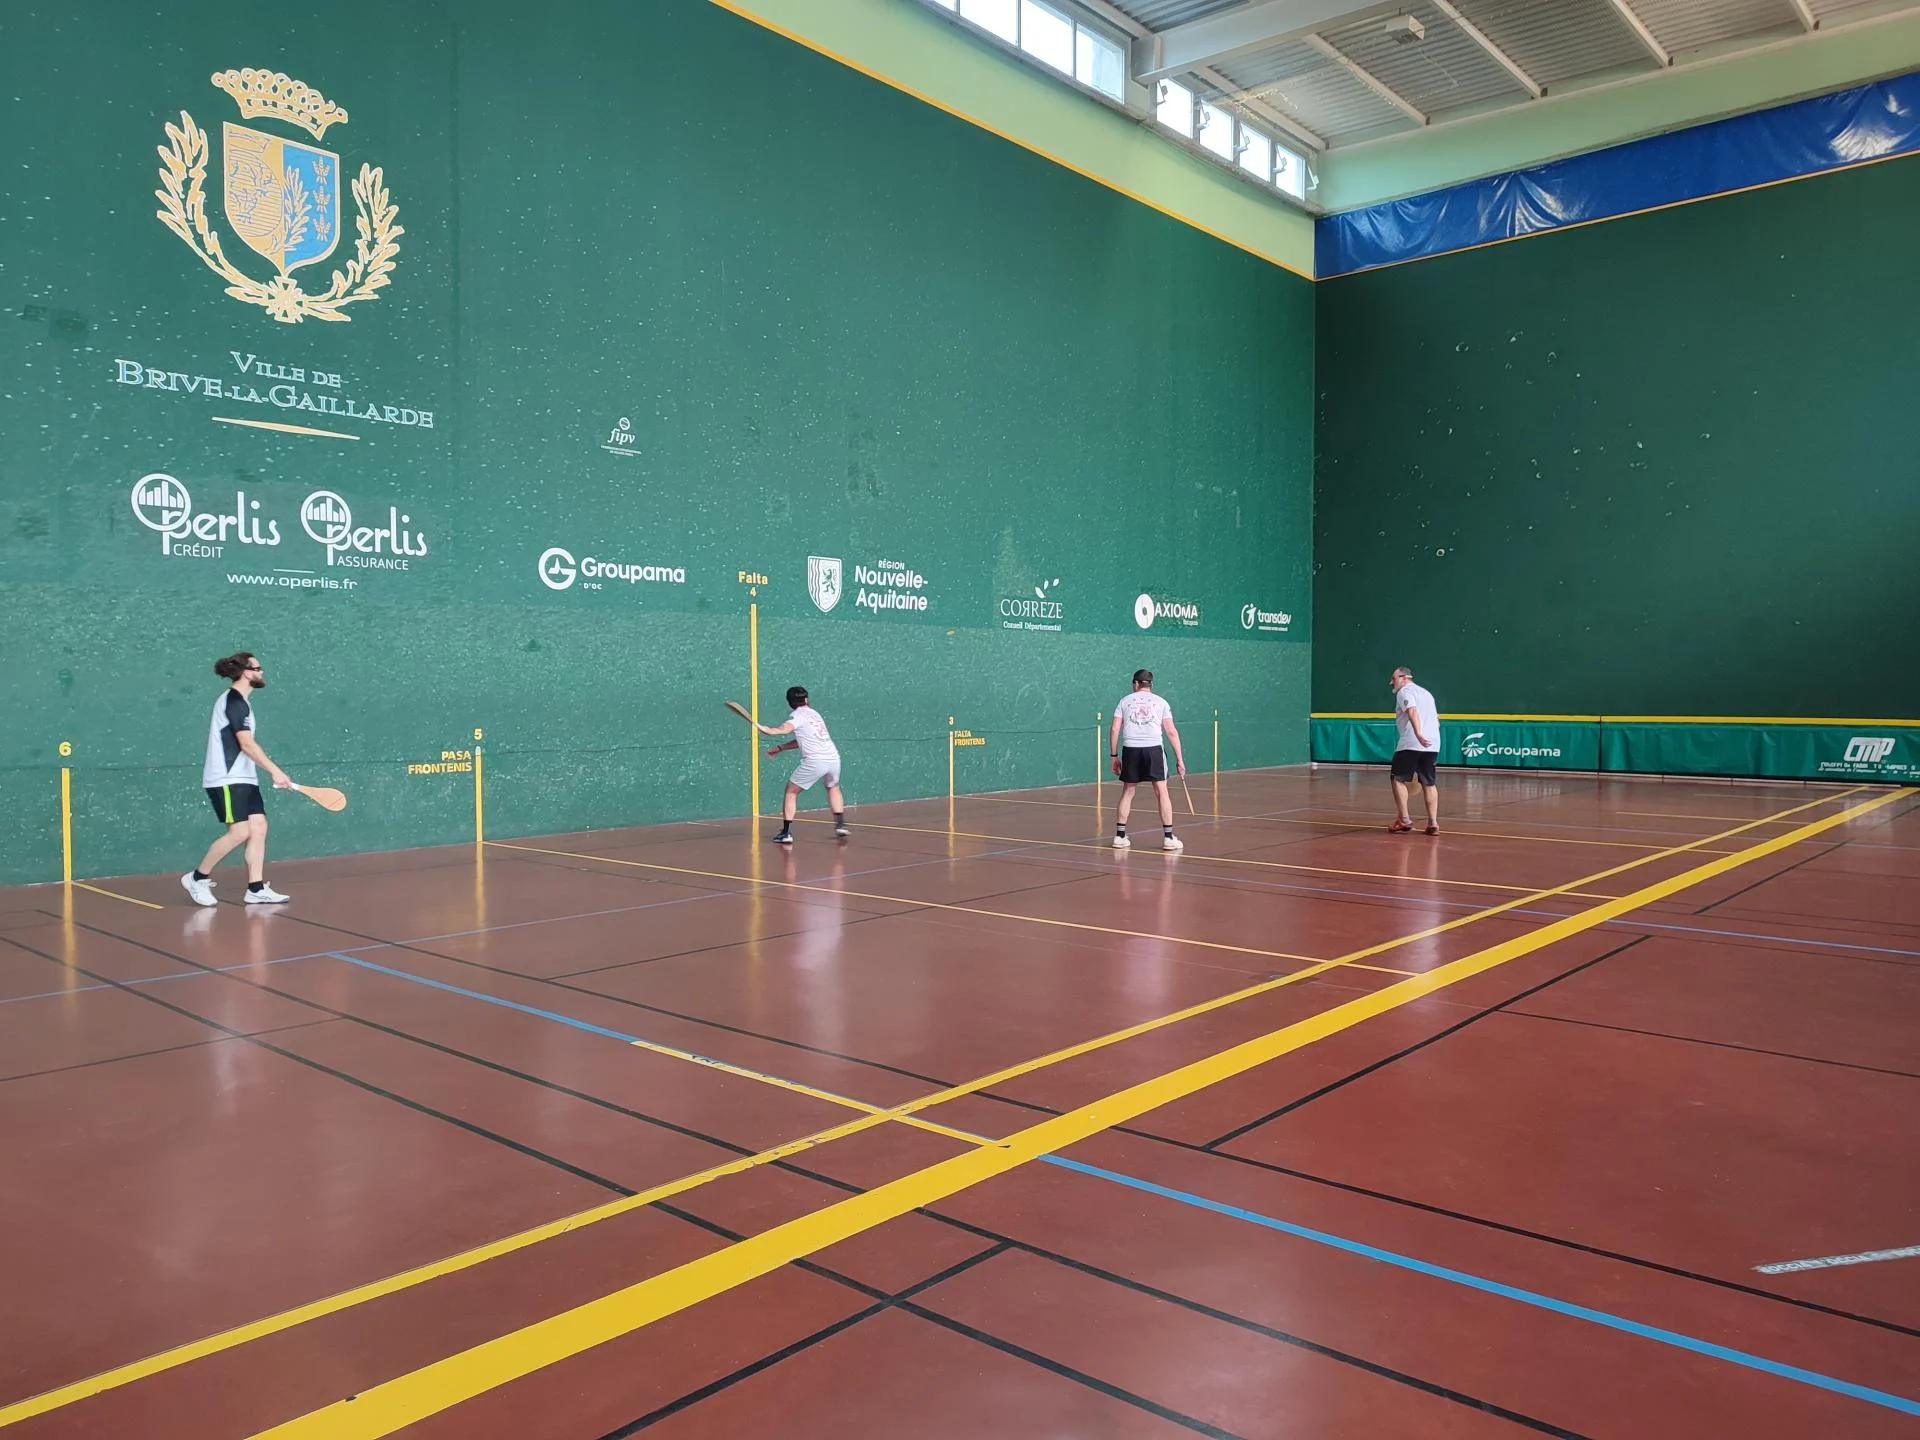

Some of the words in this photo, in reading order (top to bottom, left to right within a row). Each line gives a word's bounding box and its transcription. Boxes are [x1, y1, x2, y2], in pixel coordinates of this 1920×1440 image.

[230, 351, 305, 382] VILLE
[312, 370, 342, 388] DE
[114, 358, 434, 429] BRIVE-LA-GAILLARDE
[607, 428, 636, 446] fipv
[173, 543, 224, 559] CRÉDIT
[337, 555, 409, 571] ASSURANCE
[581, 557, 686, 584] Groupama
[878, 558, 905, 571] RÉGION
[227, 572, 358, 590] www.operlis.fr
[738, 570, 769, 585] Falta
[855, 565, 929, 589] Nouvelle-
[750, 586, 757, 597] 4
[855, 588, 928, 615] Aquitaine
[1154, 601, 1199, 619] AXIOMA
[1257, 609, 1292, 625] transdev
[948, 715, 954, 726] 3
[474, 728, 483, 740] 5
[59, 741, 72, 757] 6
[441, 750, 472, 761] PASA
[1486, 743, 1562, 758] Groupama
[408, 762, 473, 775] FRONTENIS
